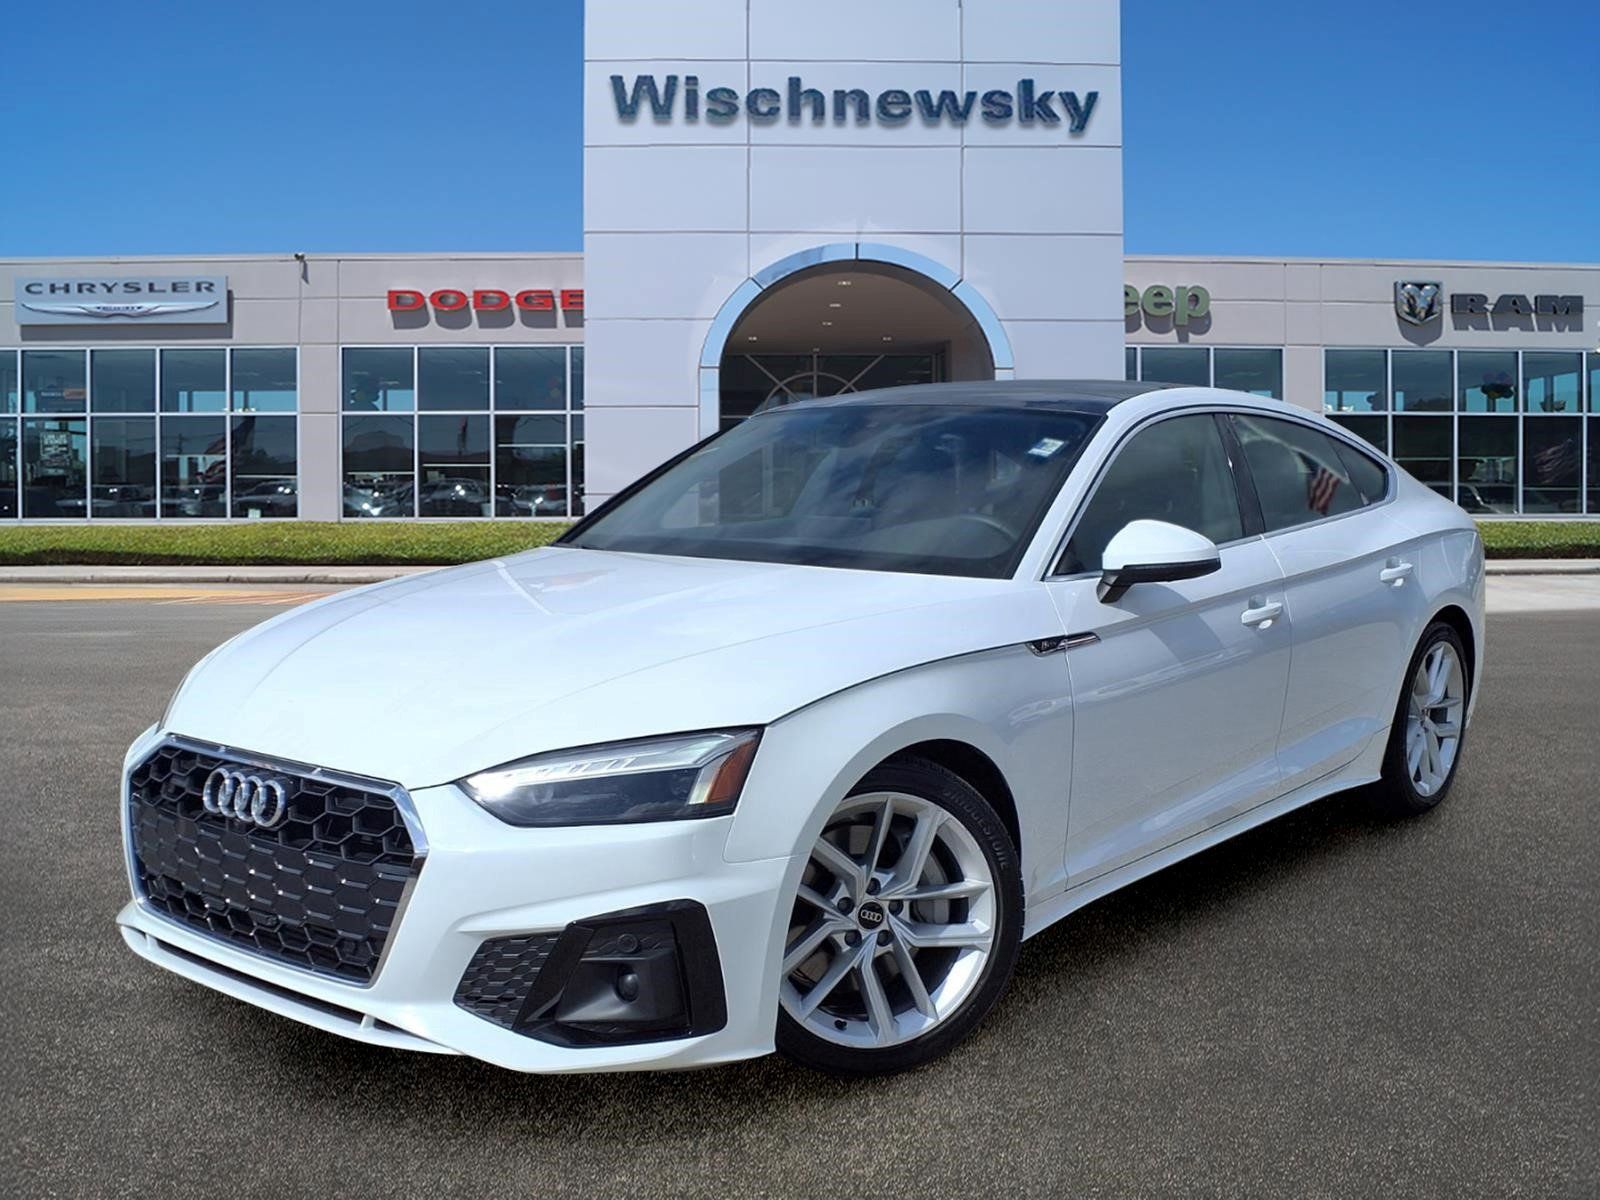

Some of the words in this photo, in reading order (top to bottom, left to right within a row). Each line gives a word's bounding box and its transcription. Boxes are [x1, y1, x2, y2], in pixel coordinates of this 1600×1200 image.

[609, 74, 1099, 133] Wischnewsky
[25, 281, 215, 295] CHRYSLER
[1450, 293, 1585, 314] RAM
